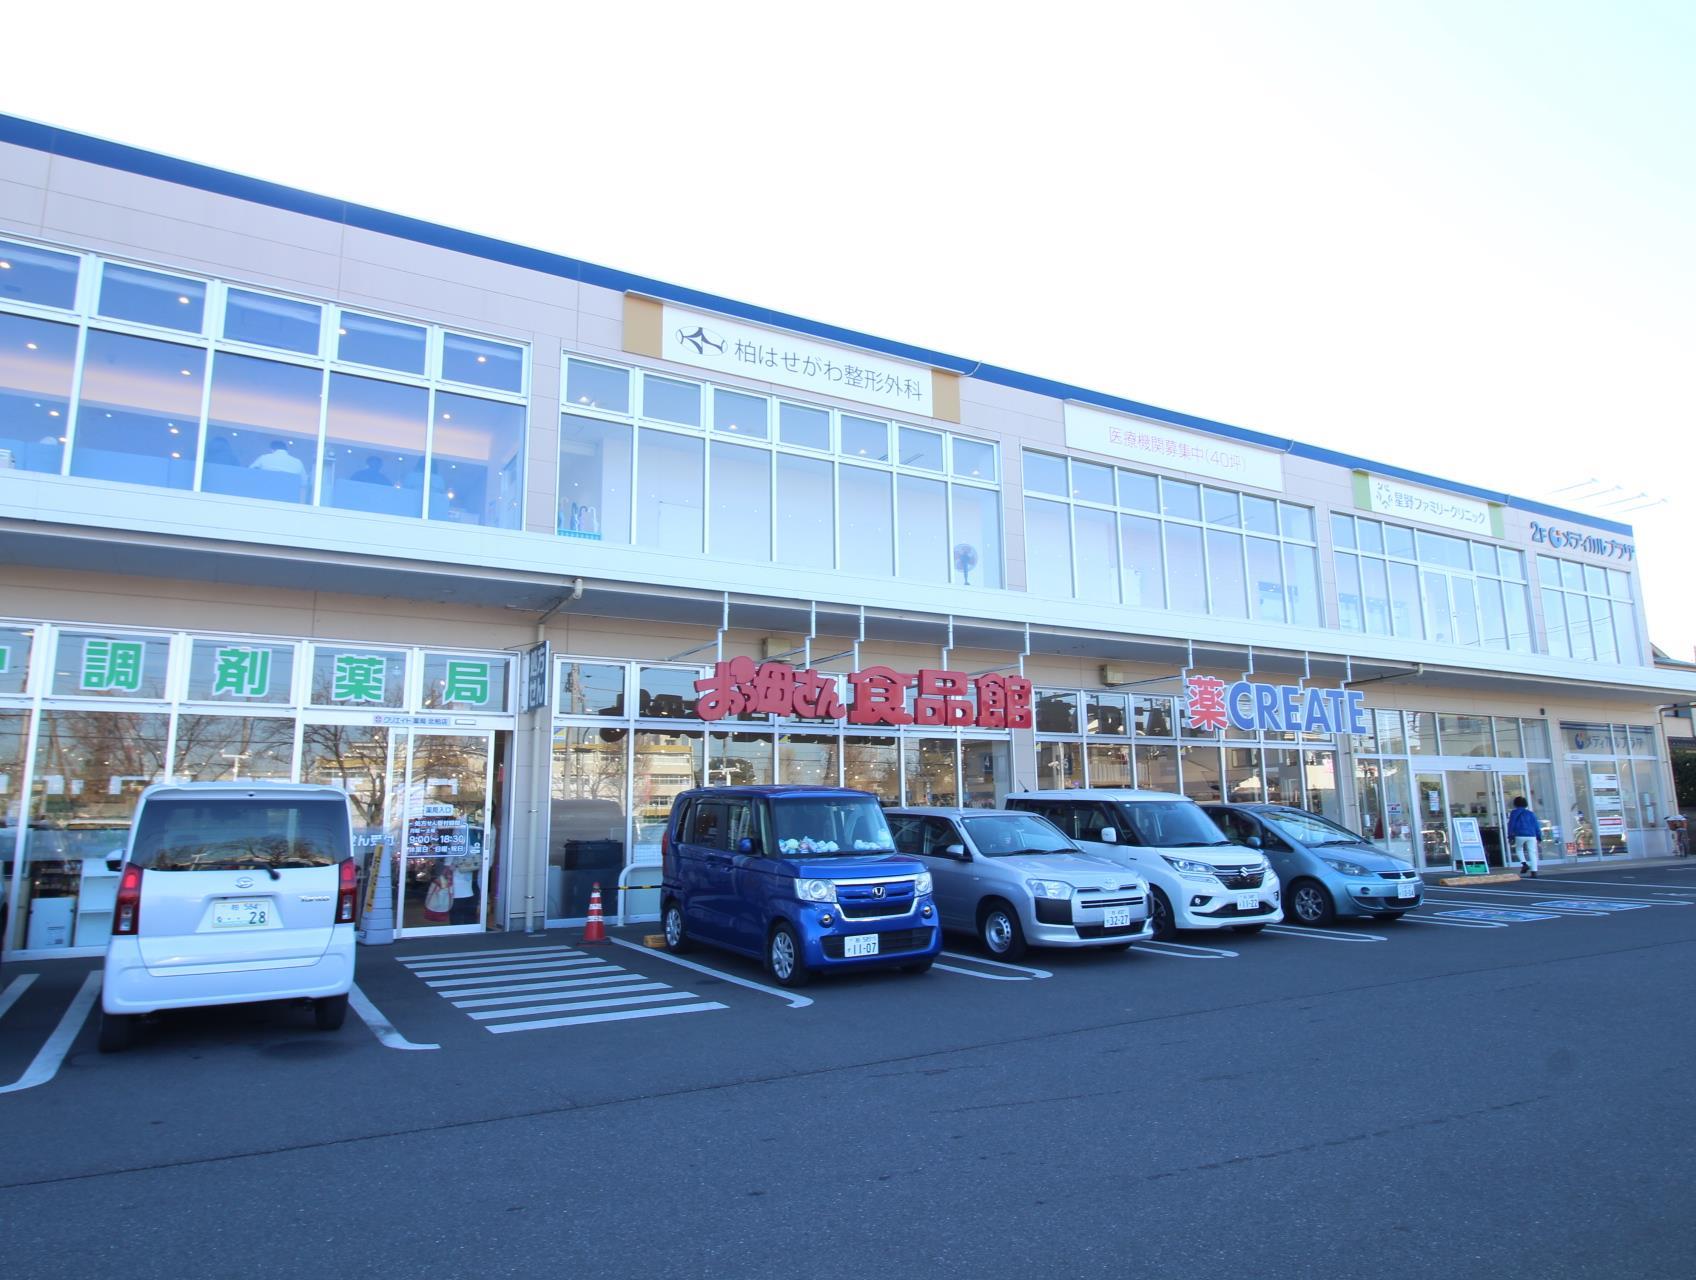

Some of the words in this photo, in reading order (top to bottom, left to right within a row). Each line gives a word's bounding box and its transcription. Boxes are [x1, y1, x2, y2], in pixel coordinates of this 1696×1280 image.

[734, 338, 923, 401] 柏はせがわ整形外科
[1394, 491, 1486, 524] 星野ファミリークリニック
[248, 911, 266, 925] 28
[853, 942, 877, 955] 11-07
